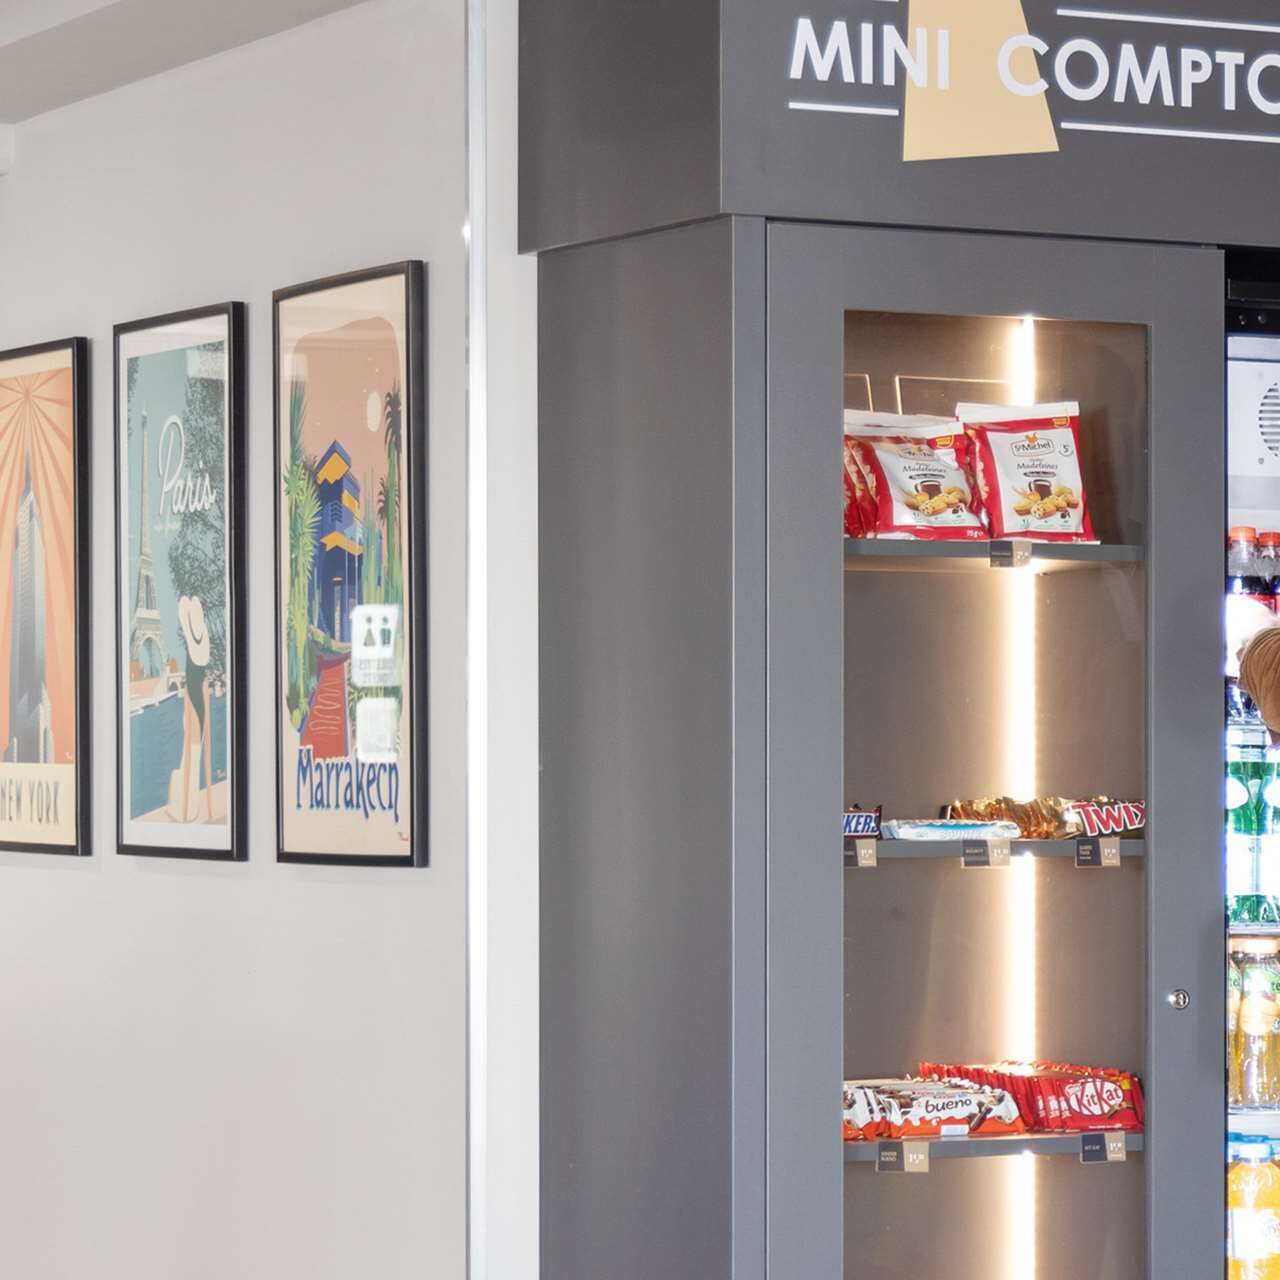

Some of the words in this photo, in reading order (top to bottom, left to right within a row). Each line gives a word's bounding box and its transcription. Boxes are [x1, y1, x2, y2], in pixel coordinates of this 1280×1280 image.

[788, 17, 950, 90] MINI
[158, 415, 217, 514] Paris
[903, 465, 947, 474] Madeleines
[1017, 462, 1058, 471] Madeleines
[28, 779, 60, 825] YORK
[843, 812, 881, 836] KERS
[925, 1097, 972, 1114] bueno
